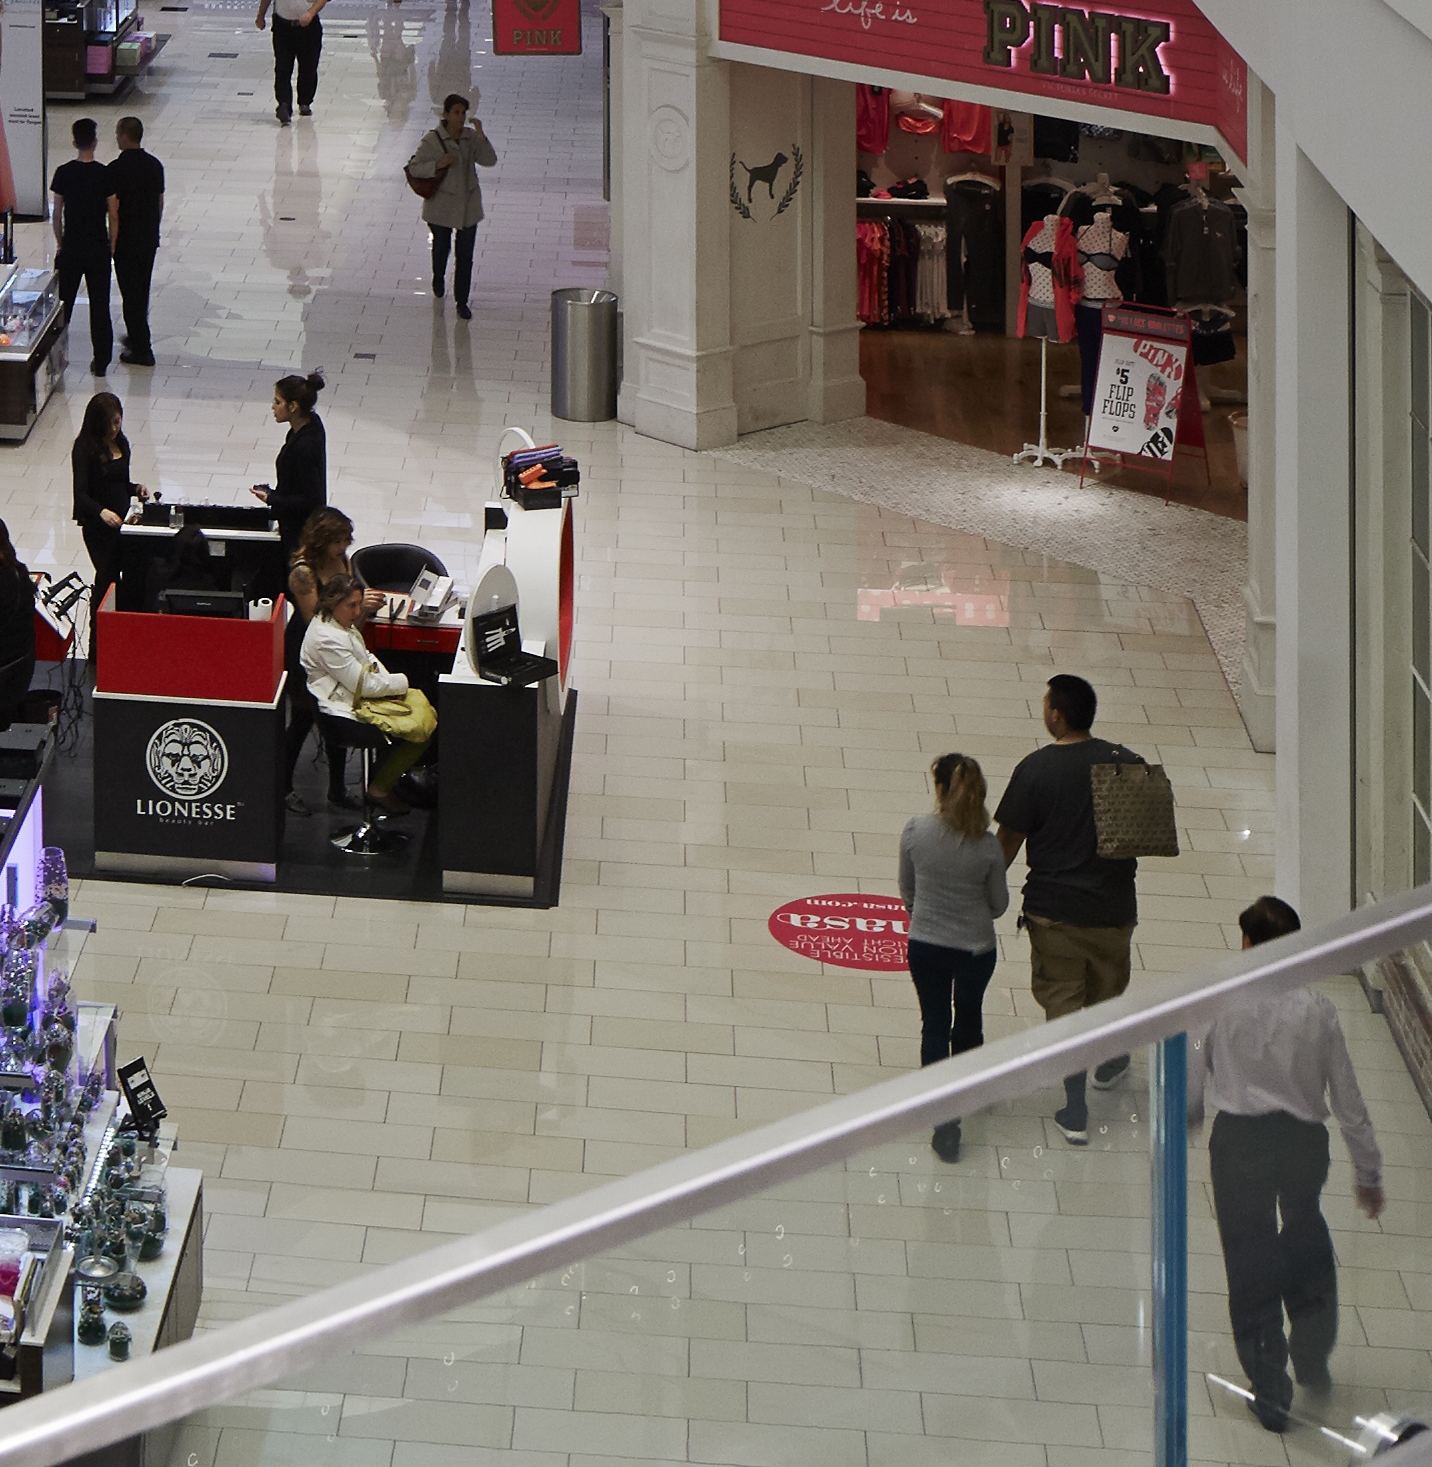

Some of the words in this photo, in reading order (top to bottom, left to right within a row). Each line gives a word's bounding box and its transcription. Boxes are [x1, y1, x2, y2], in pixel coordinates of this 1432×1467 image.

[891, 0, 918, 24] is
[512, 28, 563, 46] PINK
[1108, 383, 1135, 402] FLIP
[1101, 398, 1137, 420] FLOPS
[136, 799, 236, 820] LIONESSE
[788, 939, 854, 953] VALUE
[796, 934, 854, 944] AHEAD
[809, 949, 909, 964] ESISTIBLE
